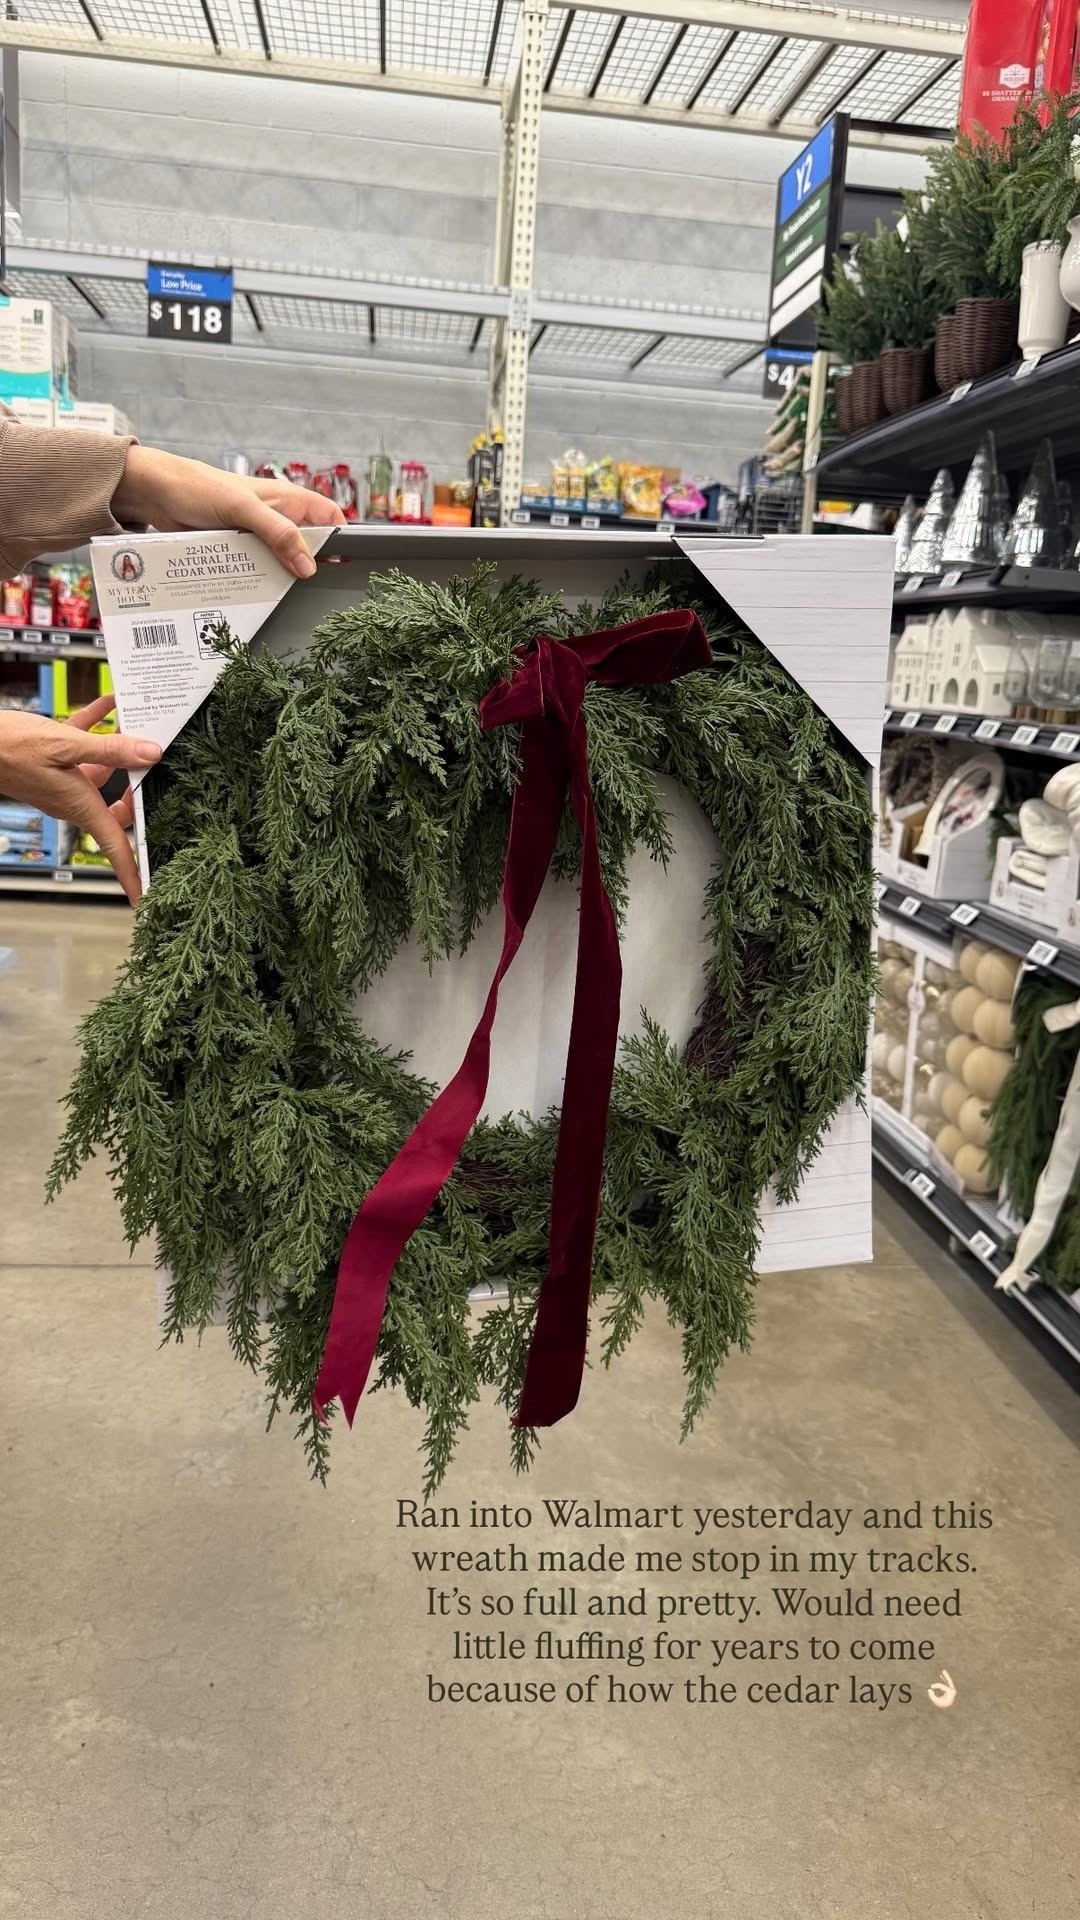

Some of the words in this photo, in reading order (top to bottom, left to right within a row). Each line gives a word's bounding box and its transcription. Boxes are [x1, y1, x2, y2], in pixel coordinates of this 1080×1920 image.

[796, 153, 813, 201] Y2
[160, 278, 180, 289] Low
[180, 280, 203, 292] Price
[186, 543, 229, 556] 22-INCH
[168, 556, 223, 568] NATURAL
[225, 552, 251, 564] FEEL
[166, 566, 205, 579] CEDAR
[207, 562, 256, 576] WREATH
[125, 584, 157, 596] TEXAS
[117, 594, 151, 604] HOUSE
